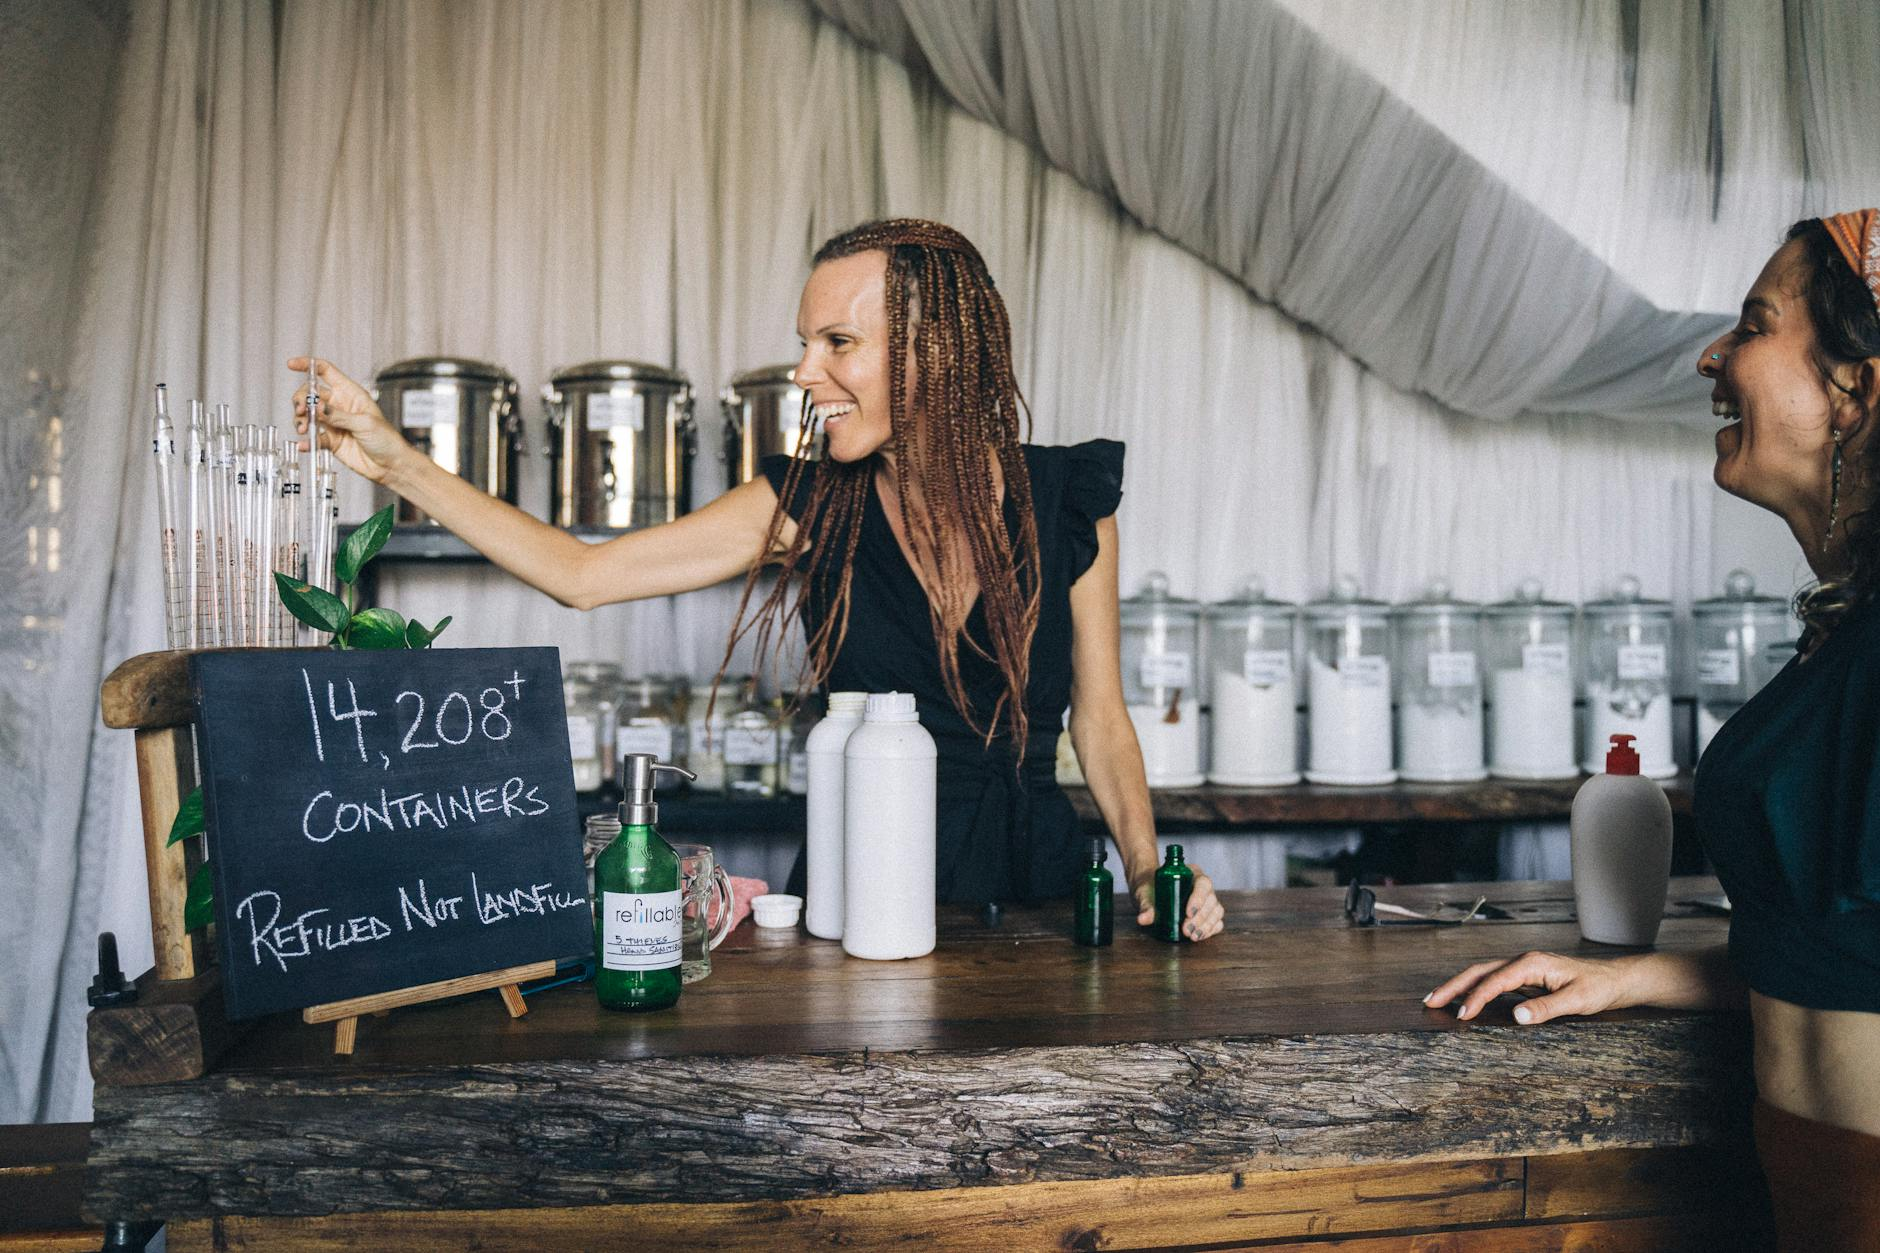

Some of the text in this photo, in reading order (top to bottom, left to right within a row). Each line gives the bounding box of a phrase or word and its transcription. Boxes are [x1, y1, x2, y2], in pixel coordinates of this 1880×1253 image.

[303, 777, 550, 842] CONTAINERS
[236, 871, 586, 973] REFILLED NOT LANDFILL
[615, 898, 681, 924] refillable
[615, 935, 622, 944] 5
